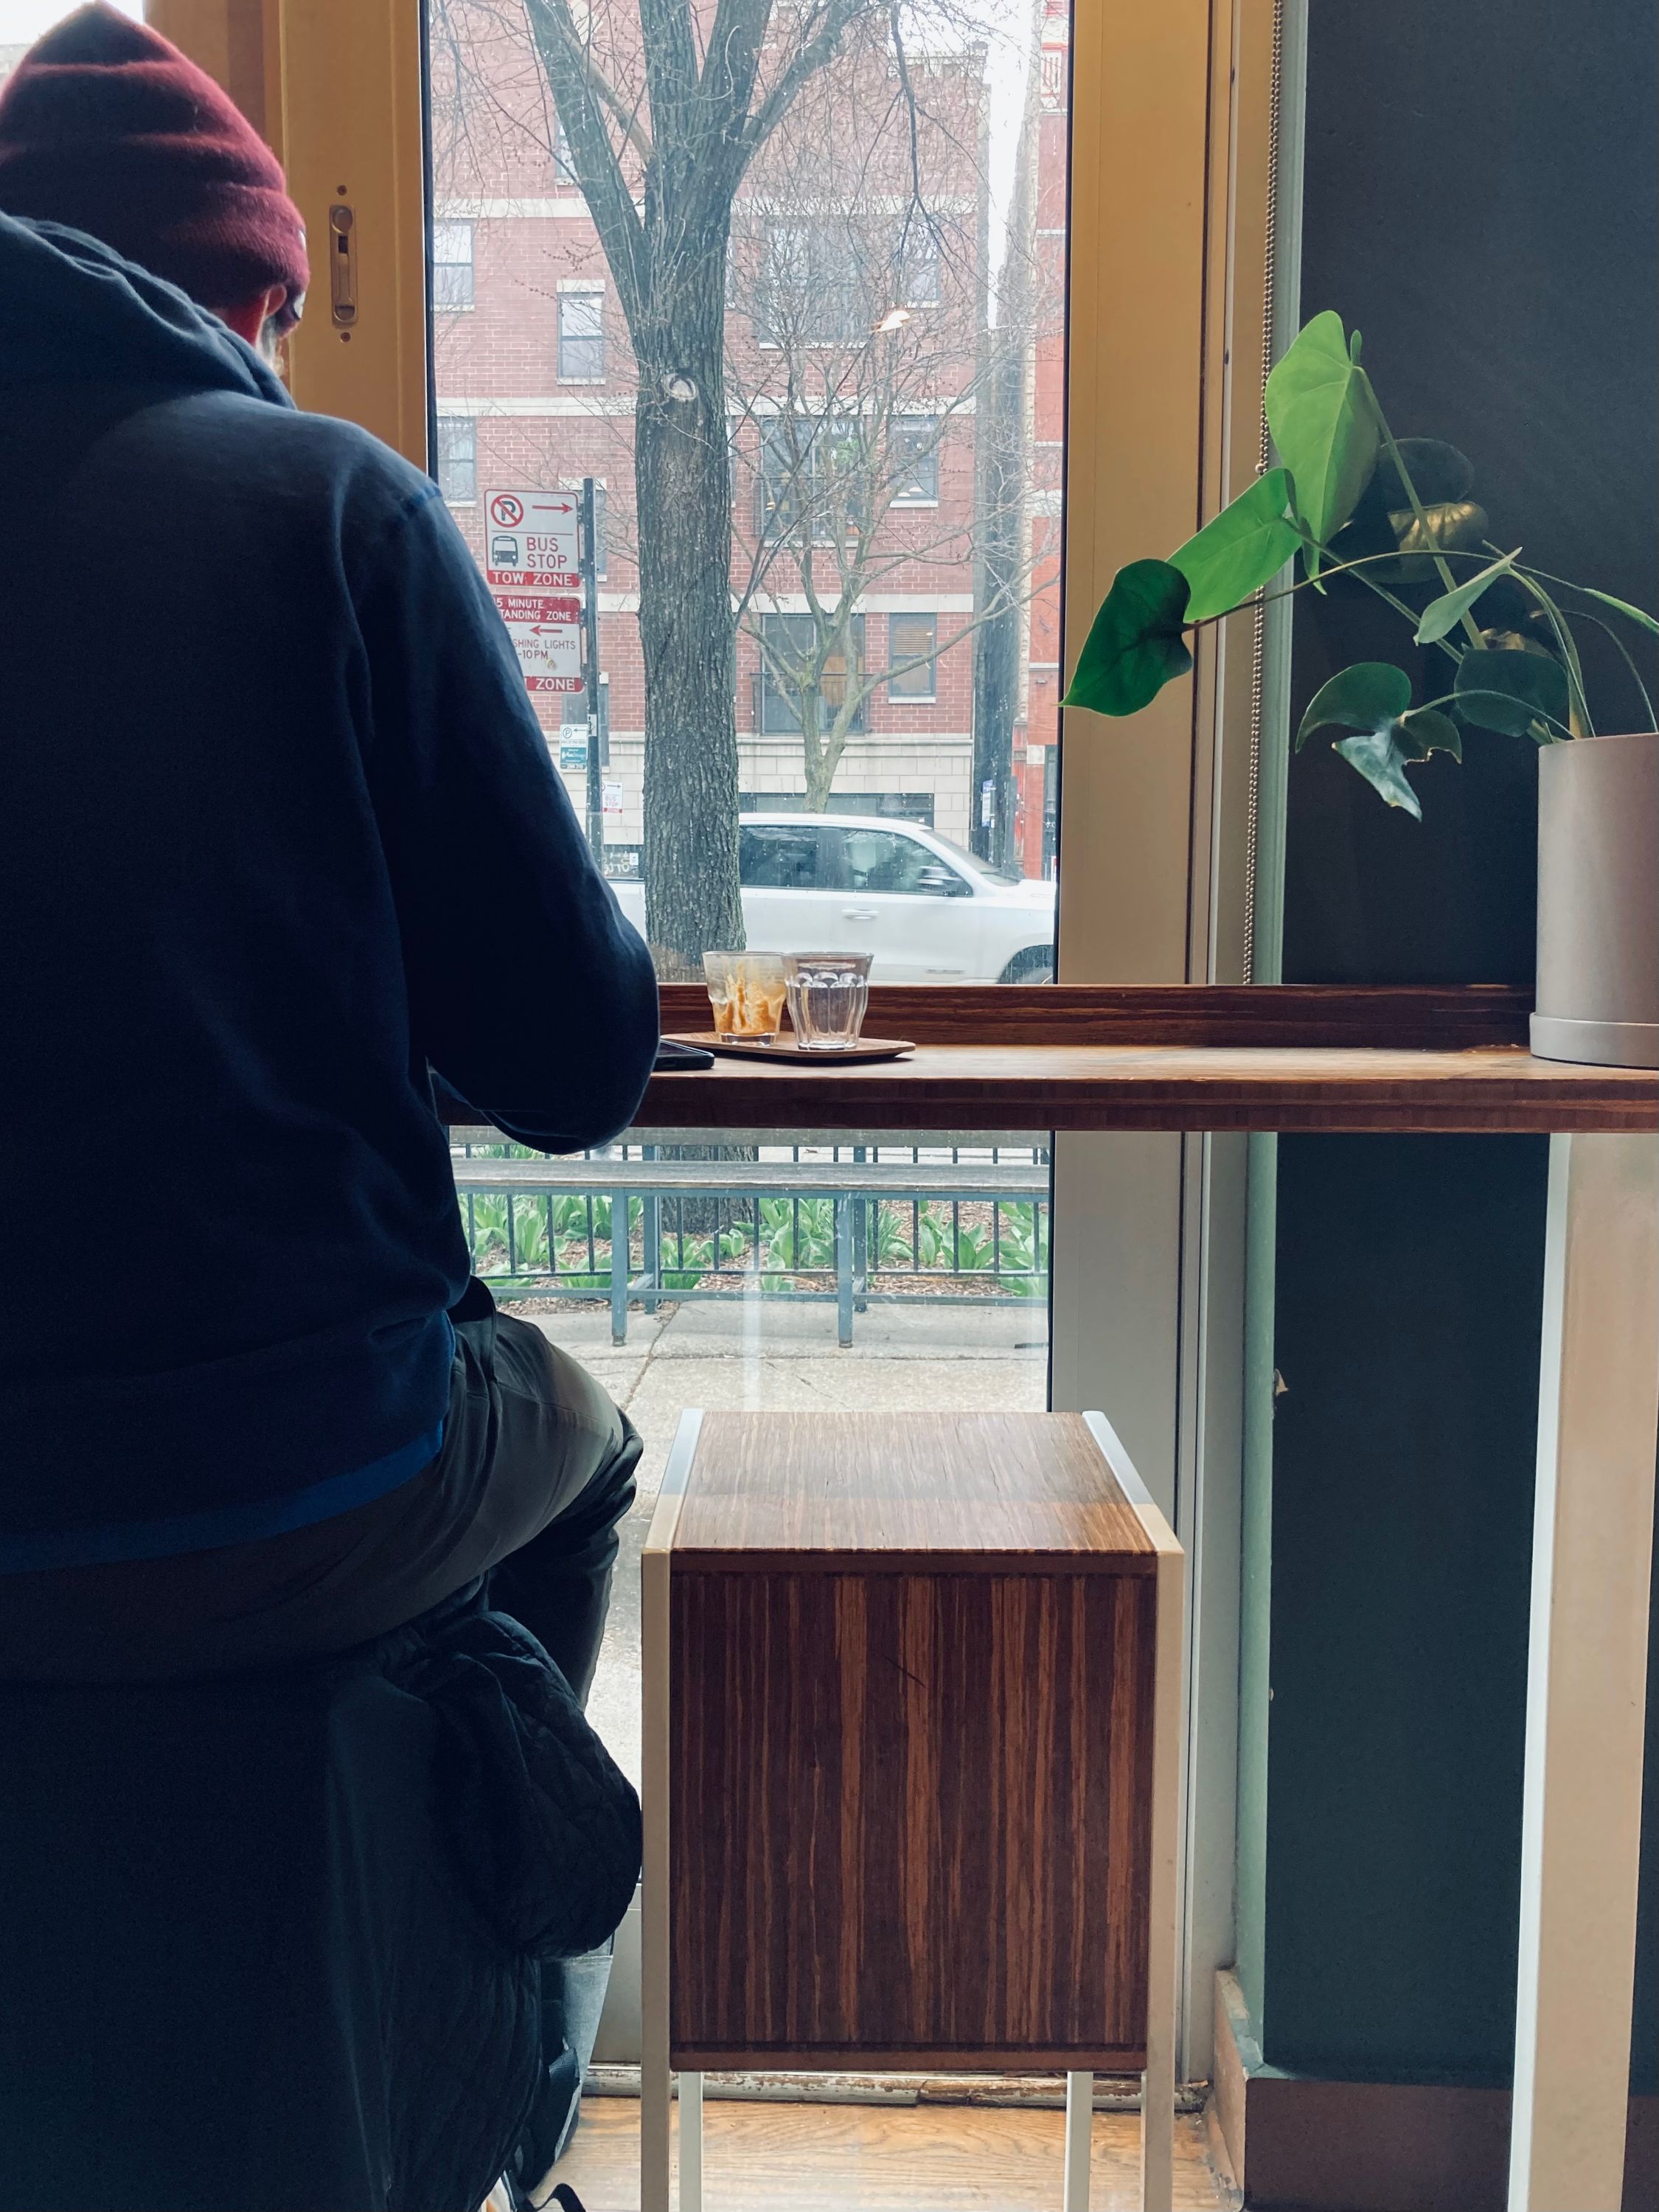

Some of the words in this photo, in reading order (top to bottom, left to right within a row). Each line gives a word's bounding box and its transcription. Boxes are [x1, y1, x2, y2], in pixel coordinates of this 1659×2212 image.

[526, 537, 559, 552] BUS
[527, 554, 567, 568] STOP
[493, 571, 524, 585] TOW
[533, 574, 573, 586] ZONE
[508, 599, 544, 609] MINUTE
[499, 609, 540, 620] TANDING
[546, 611, 571, 622] ZONE
[513, 639, 539, 649] SHING
[545, 639, 576, 650] LIGHTS
[535, 678, 575, 691] ZONE
